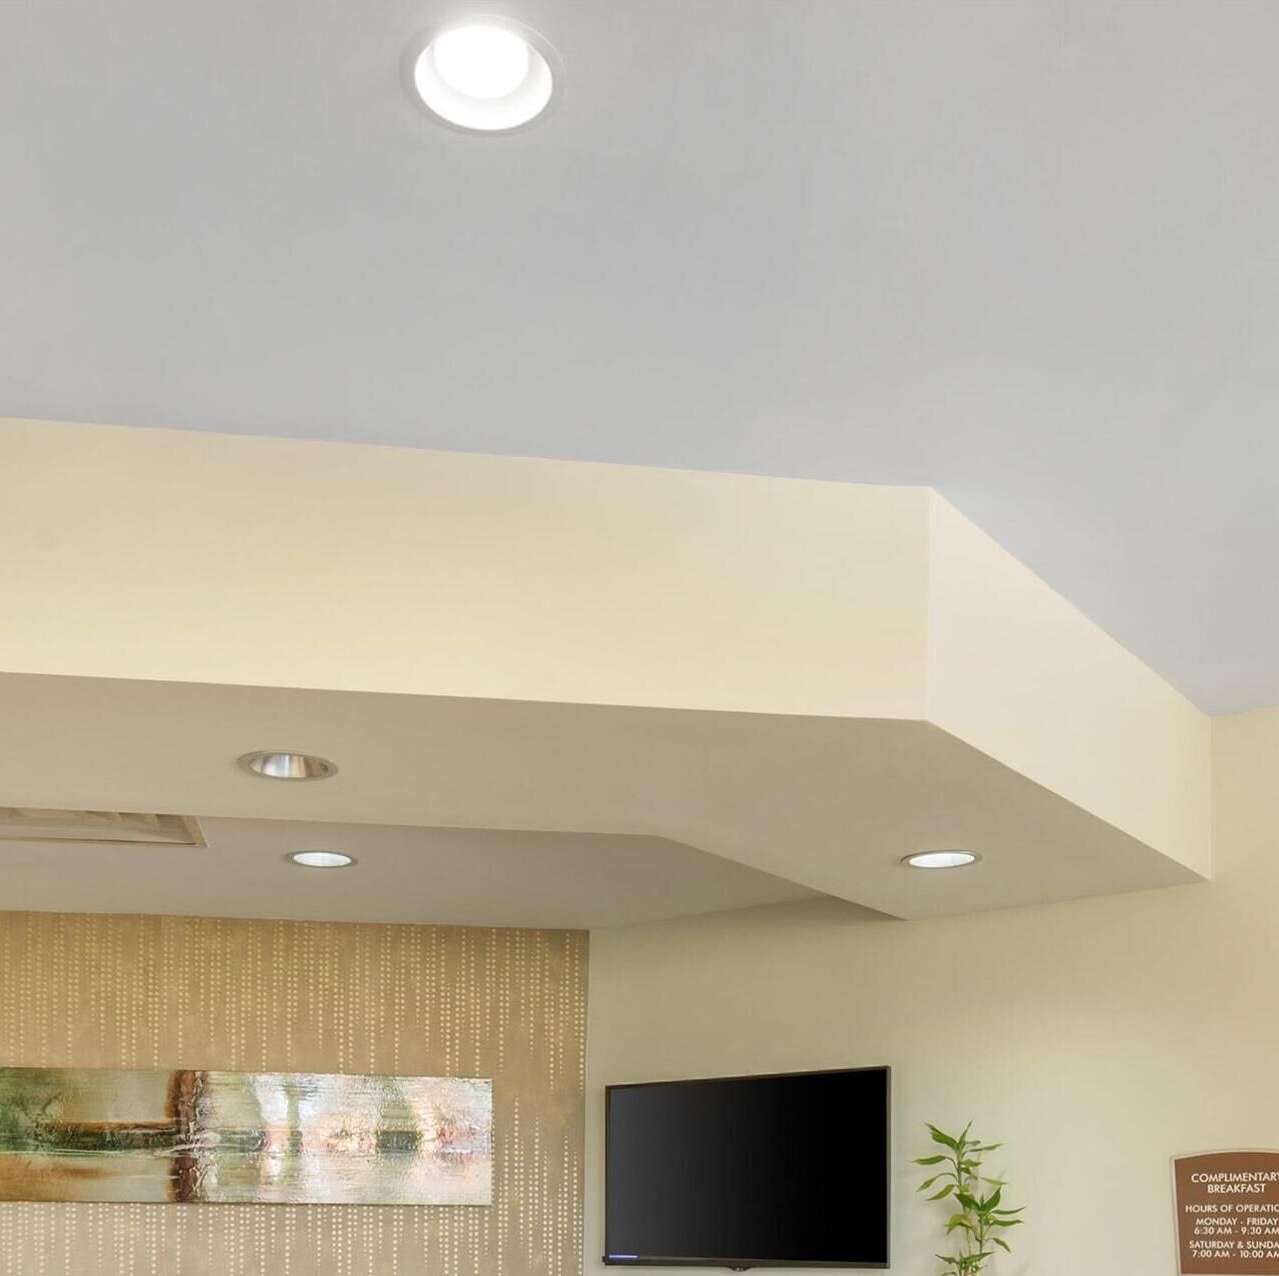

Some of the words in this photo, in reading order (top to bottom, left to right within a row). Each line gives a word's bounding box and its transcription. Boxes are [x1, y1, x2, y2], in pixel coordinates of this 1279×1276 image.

[1207, 1183, 1266, 1194] BREAKFAST
[1185, 1204, 1218, 1213] HOURS
[1220, 1204, 1233, 1213] OF
[1195, 1217, 1238, 1226] MONDAY
[1246, 1217, 1279, 1226] FRIDAY
[1194, 1226, 1215, 1235] 6:30
[1216, 1227, 1232, 1235] AM
[1240, 1226, 1262, 1235] 9:30
[1264, 1227, 1279, 1235] AM
[1189, 1240, 1234, 1249] SATURDAY
[1237, 1241, 1244, 1249] &
[1192, 1250, 1212, 1258] 7:00
[1240, 1250, 1264, 1258] 10:00
